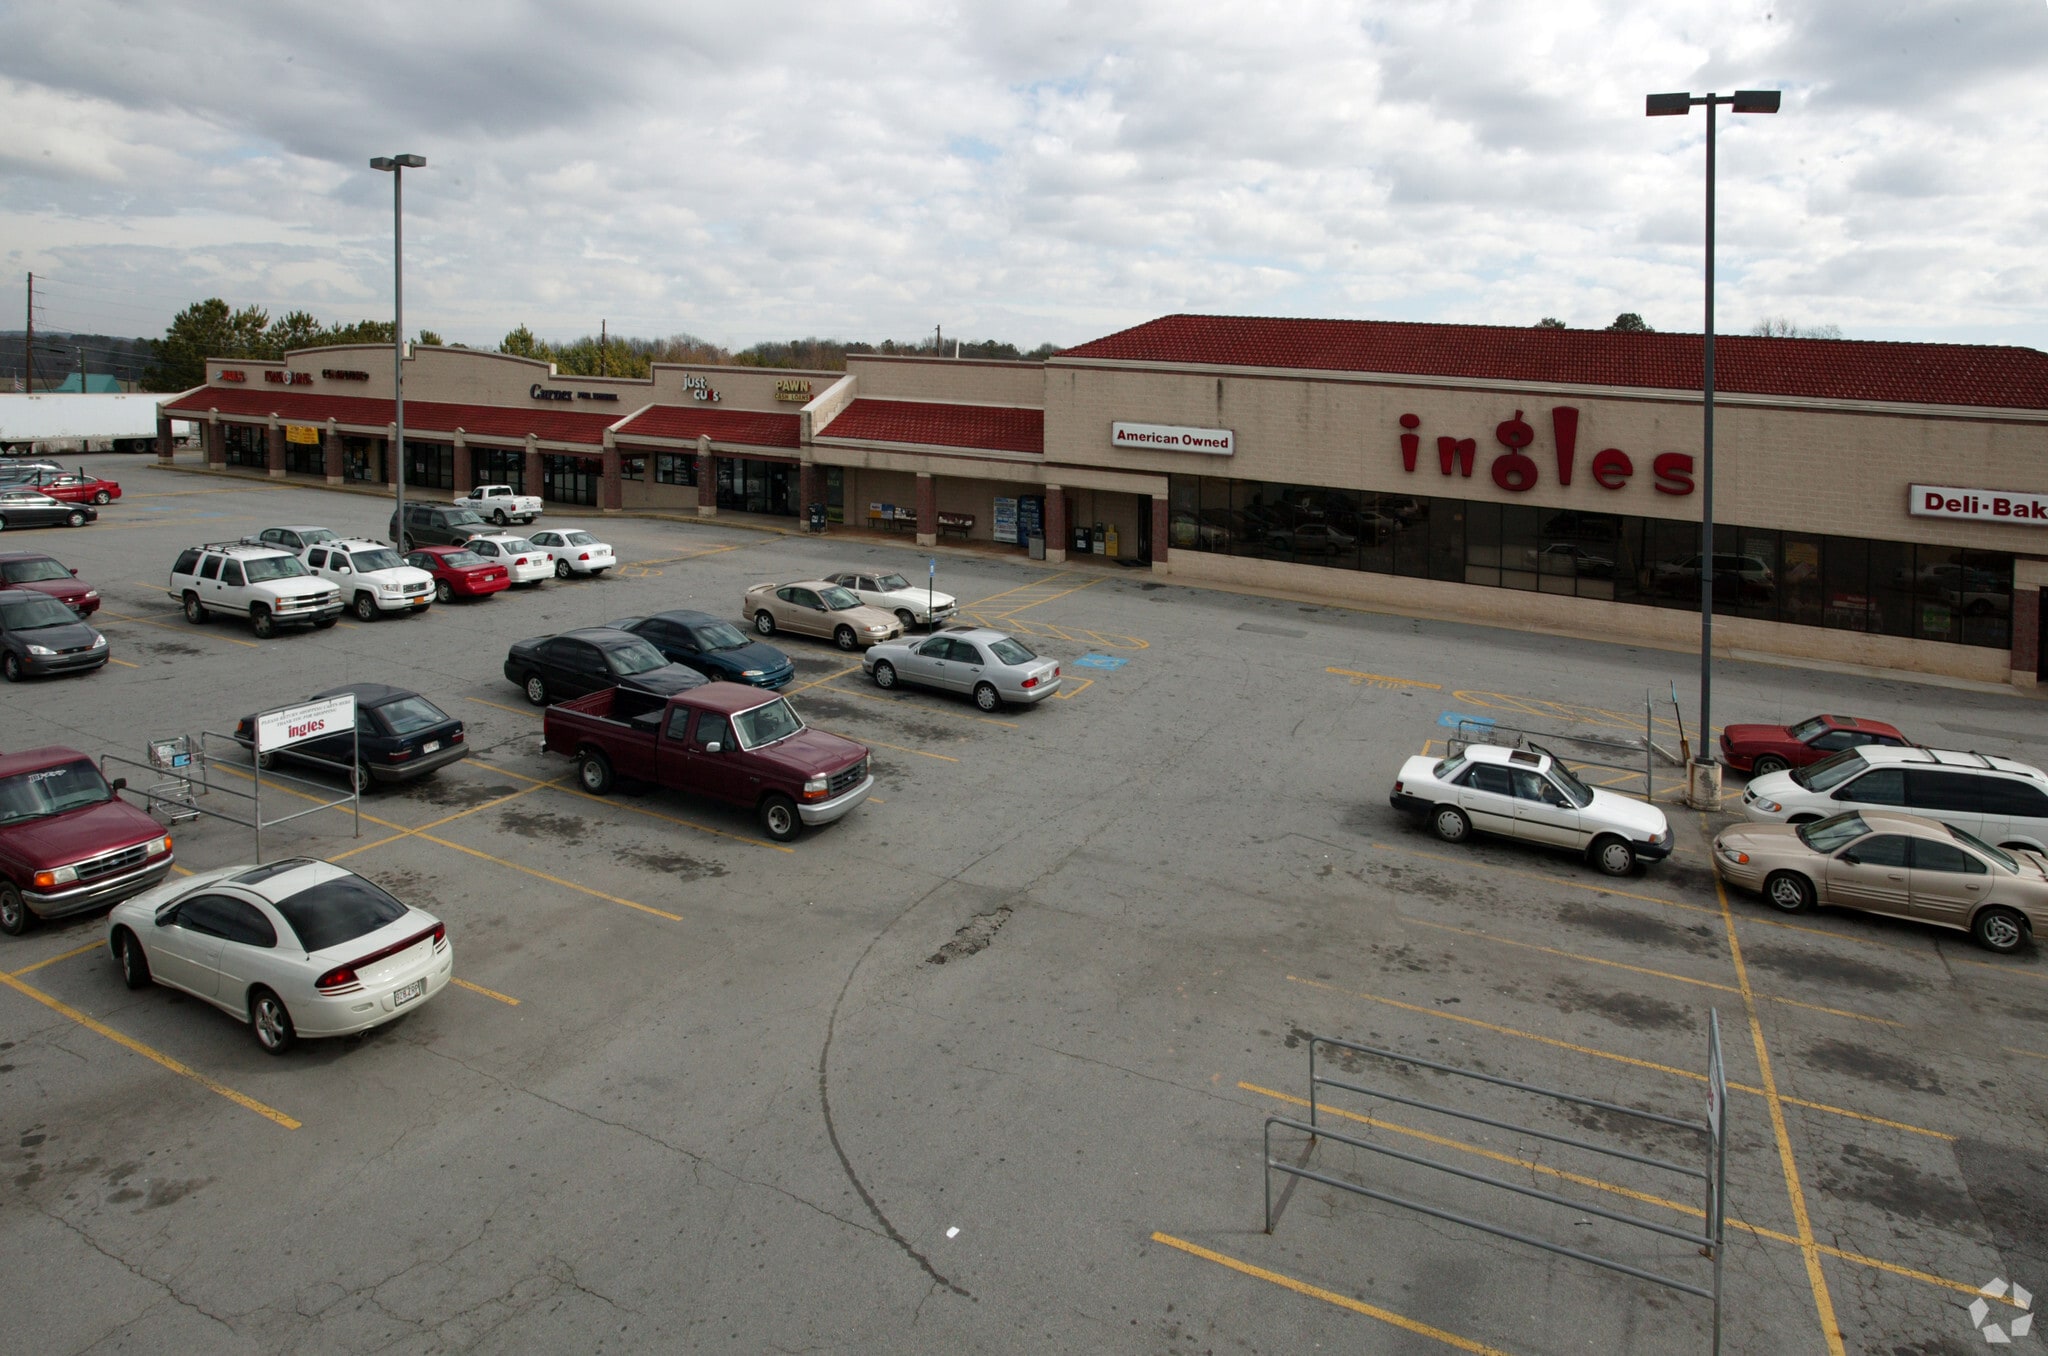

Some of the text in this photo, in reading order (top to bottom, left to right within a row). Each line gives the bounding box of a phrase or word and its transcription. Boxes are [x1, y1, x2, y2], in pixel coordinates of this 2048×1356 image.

[682, 373, 706, 390] just
[776, 380, 809, 392] PAWN
[693, 388, 720, 401] cuts
[1117, 429, 1229, 448] American Owned
[1400, 405, 1696, 496] ingles
[288, 719, 325, 738] ingles
